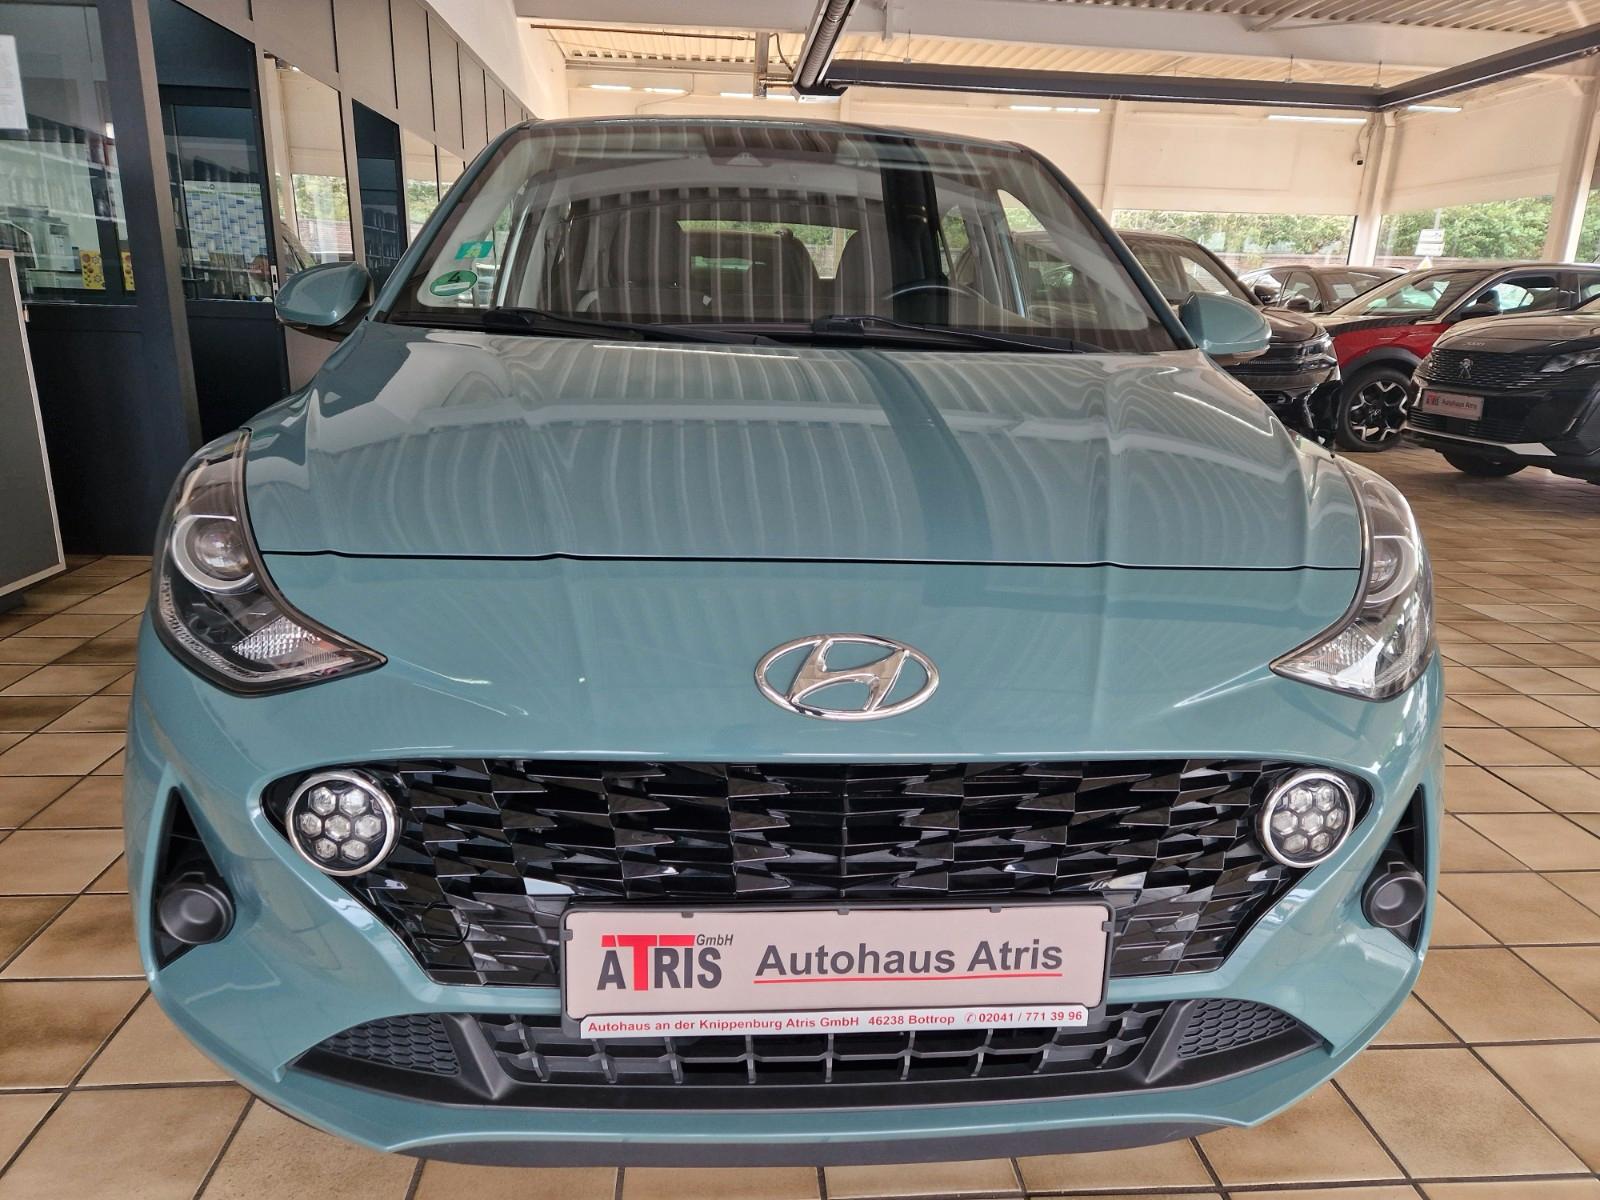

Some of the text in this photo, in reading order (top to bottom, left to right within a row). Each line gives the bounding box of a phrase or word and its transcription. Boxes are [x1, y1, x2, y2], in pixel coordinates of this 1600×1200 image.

[696, 934, 733, 946] GmbH
[597, 935, 722, 991] ATRIS
[755, 938, 1063, 977] Autohaus Atris
[588, 1020, 650, 1032] Autohaus
[655, 1021, 670, 1031] an
[674, 1018, 695, 1030] der
[699, 1017, 782, 1031] Knippenburg
[786, 1017, 816, 1028] Atris
[820, 1016, 859, 1027] GmbH
[868, 1015, 904, 1026] 46238
[908, 1014, 955, 1025] Bottrop
[979, 1012, 1013, 1023] 02041
[1026, 1011, 1045, 1022] 771
[1051, 1011, 1064, 1021] 39
[1068, 1010, 1082, 1021] 96
